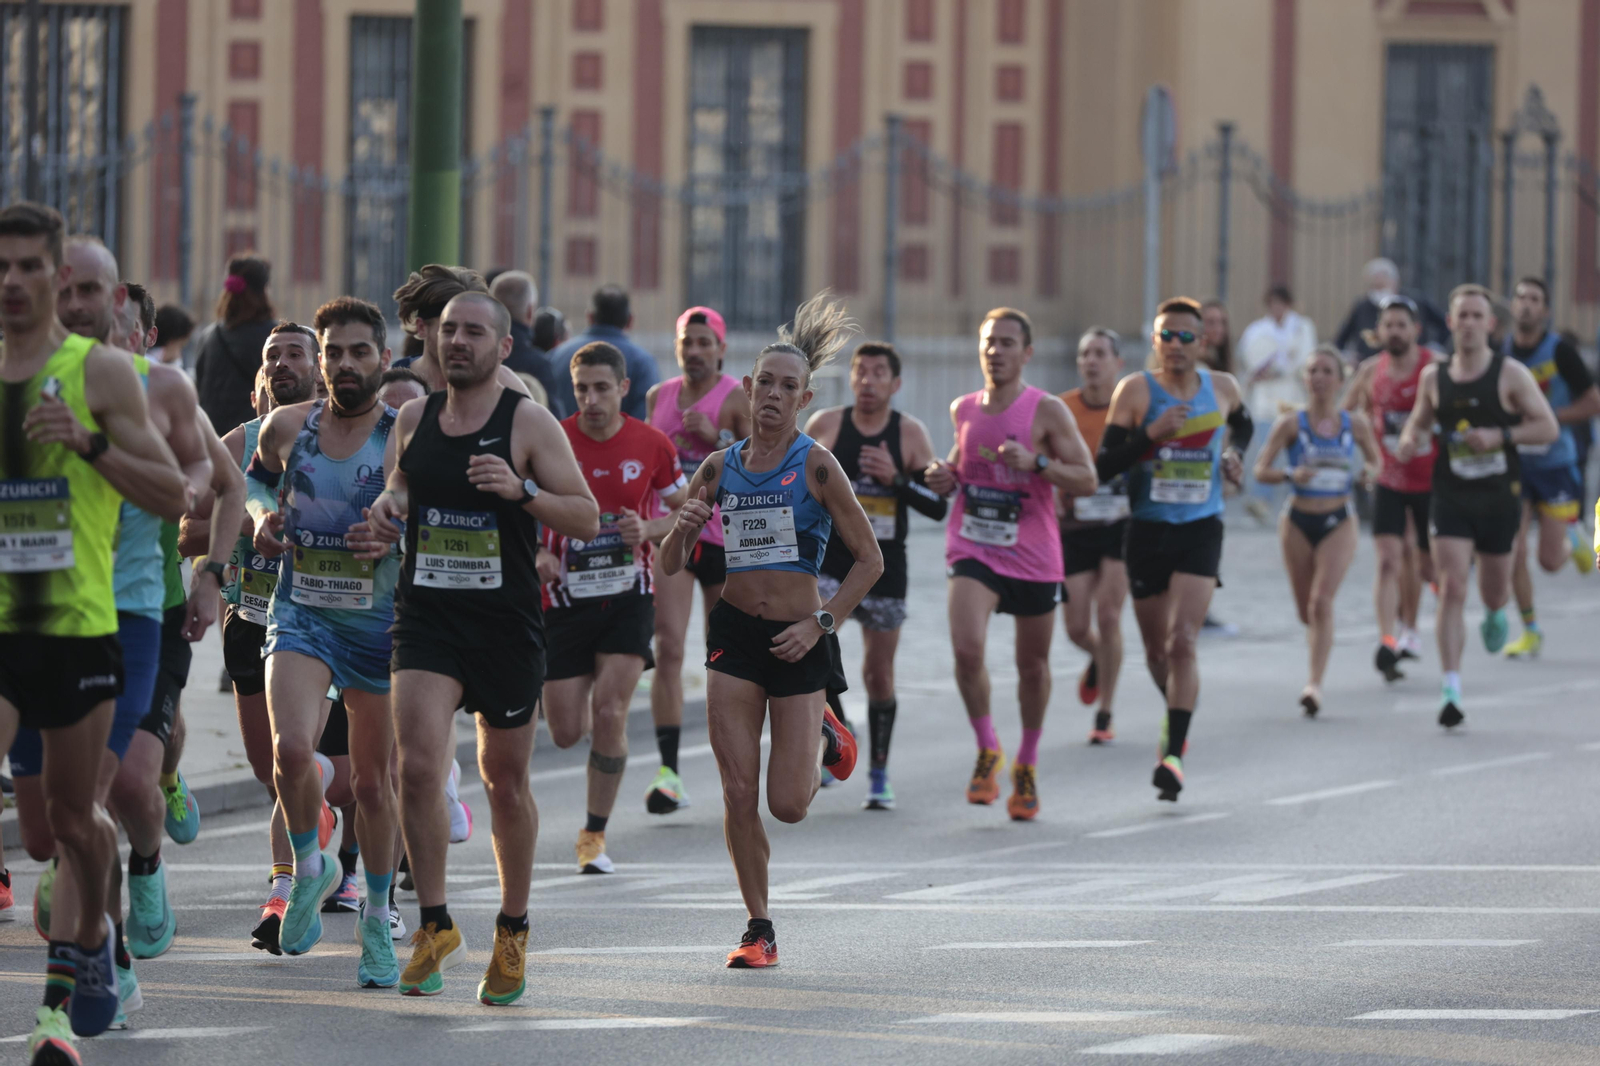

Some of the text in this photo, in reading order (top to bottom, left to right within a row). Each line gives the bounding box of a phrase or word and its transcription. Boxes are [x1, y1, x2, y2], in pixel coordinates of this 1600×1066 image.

[0, 481, 58, 499] ZURICH
[740, 494, 783, 507] ZURICH
[743, 518, 767, 531] F229
[443, 539, 469, 552] 1261
[739, 536, 776, 548] ADRIANA
[319, 560, 341, 572] 878
[425, 557, 491, 570] LUIS COIMBRA
[300, 576, 362, 591] FABIO-THIAGO
[244, 595, 269, 609] CESAR
